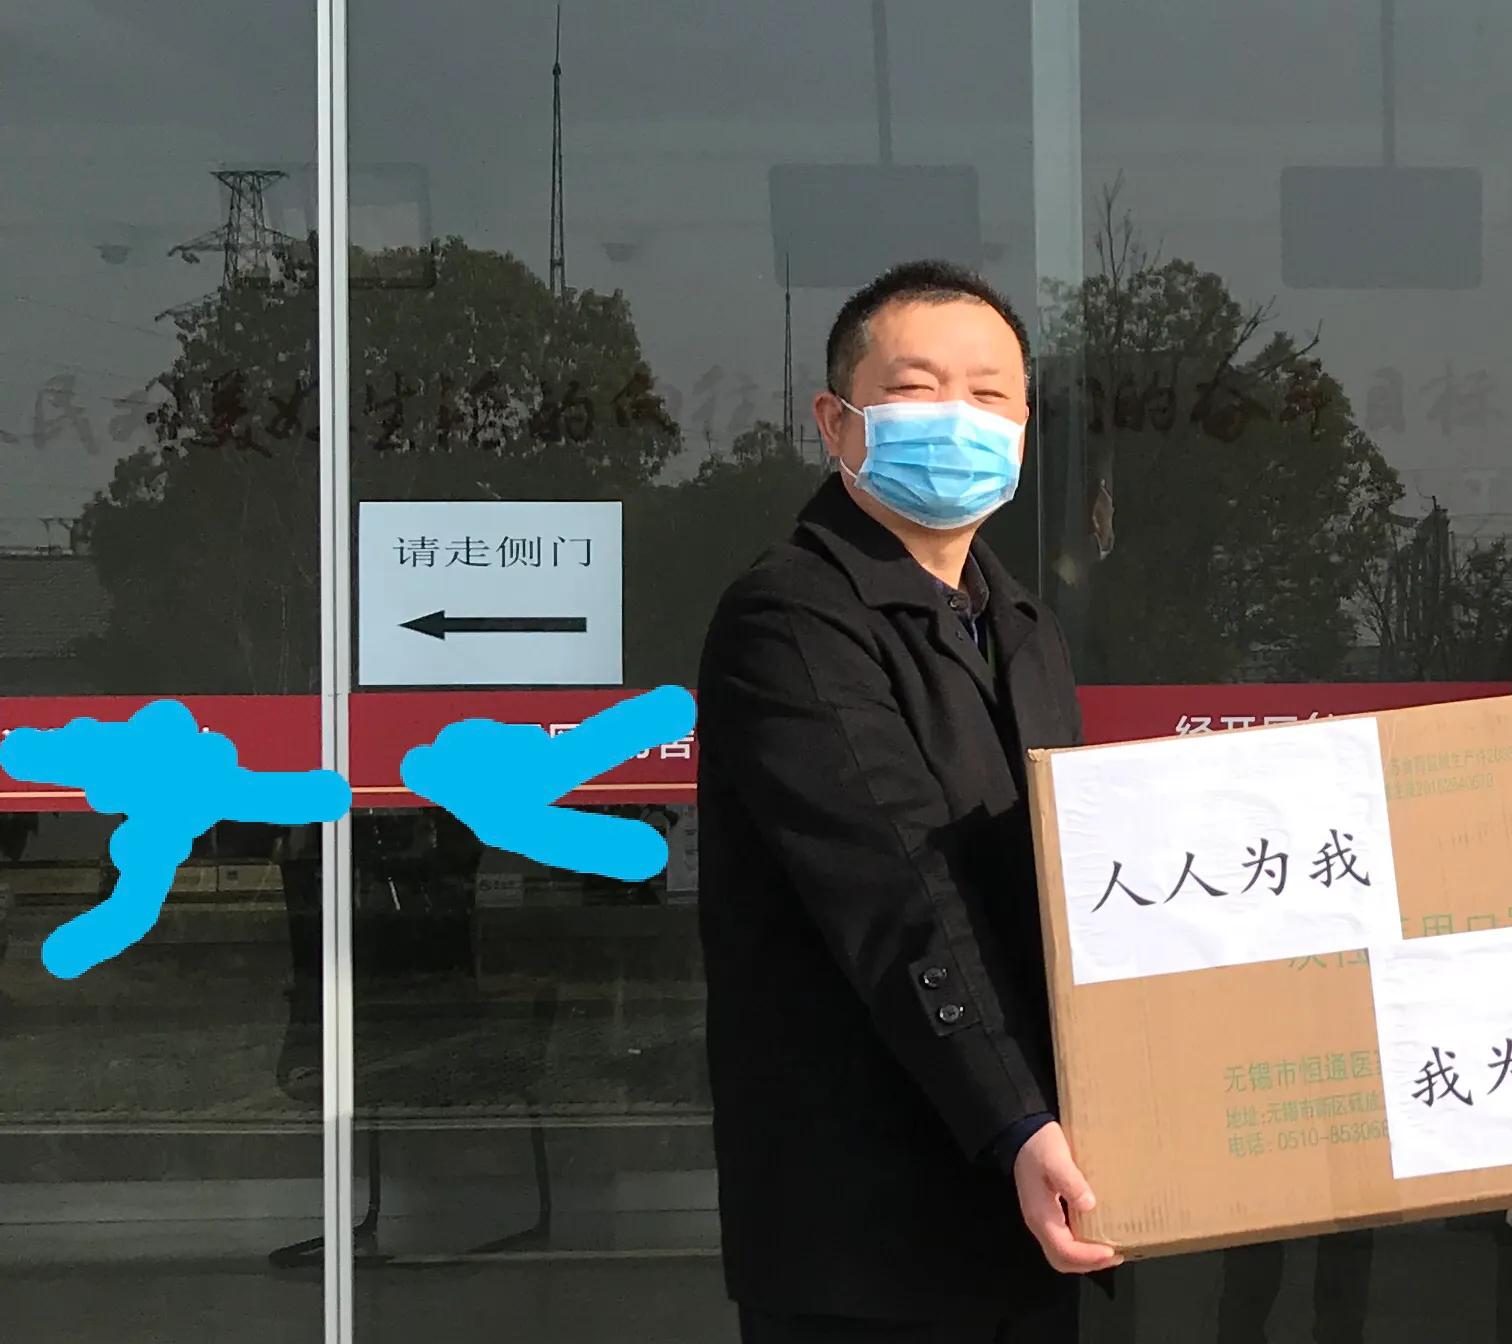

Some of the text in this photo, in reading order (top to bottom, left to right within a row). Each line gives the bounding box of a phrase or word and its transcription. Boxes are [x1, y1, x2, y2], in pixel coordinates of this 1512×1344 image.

[393, 535, 593, 568] 请走侧门
[1090, 828, 1372, 913] 人人为我
[1224, 1049, 1381, 1093] 无锡市恒通医
